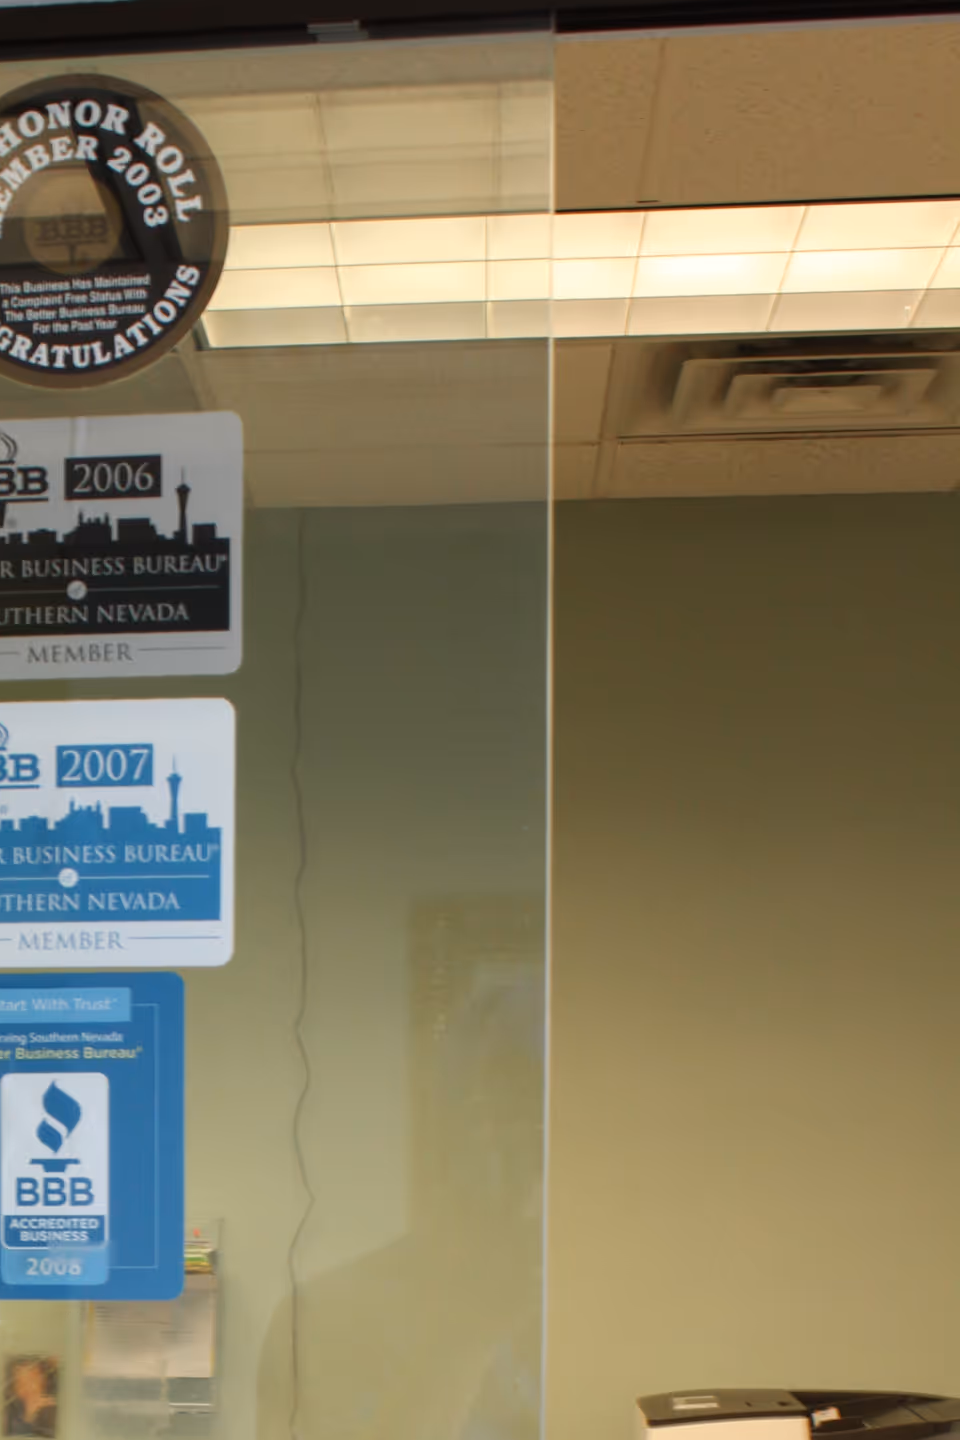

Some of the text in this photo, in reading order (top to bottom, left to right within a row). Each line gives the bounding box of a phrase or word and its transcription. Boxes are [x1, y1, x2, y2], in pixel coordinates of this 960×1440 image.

[135, 122, 201, 222] ROLL
[108, 148, 168, 228] 2003
[72, 462, 153, 492] 2006
[21, 557, 124, 578] BUSINESS
[96, 604, 188, 623] NEVADA
[27, 644, 133, 664] MEMBER
[61, 749, 148, 781] 2007
[13, 846, 115, 864] BUSINESS
[88, 892, 180, 910] NEVADA
[18, 932, 124, 950] MEMBER
[16, 1177, 94, 1206] BBB
[10, 1219, 99, 1229] ACCREDITED
[20, 1231, 88, 1241] BUSINESS
[26, 1258, 82, 1275] 2008
